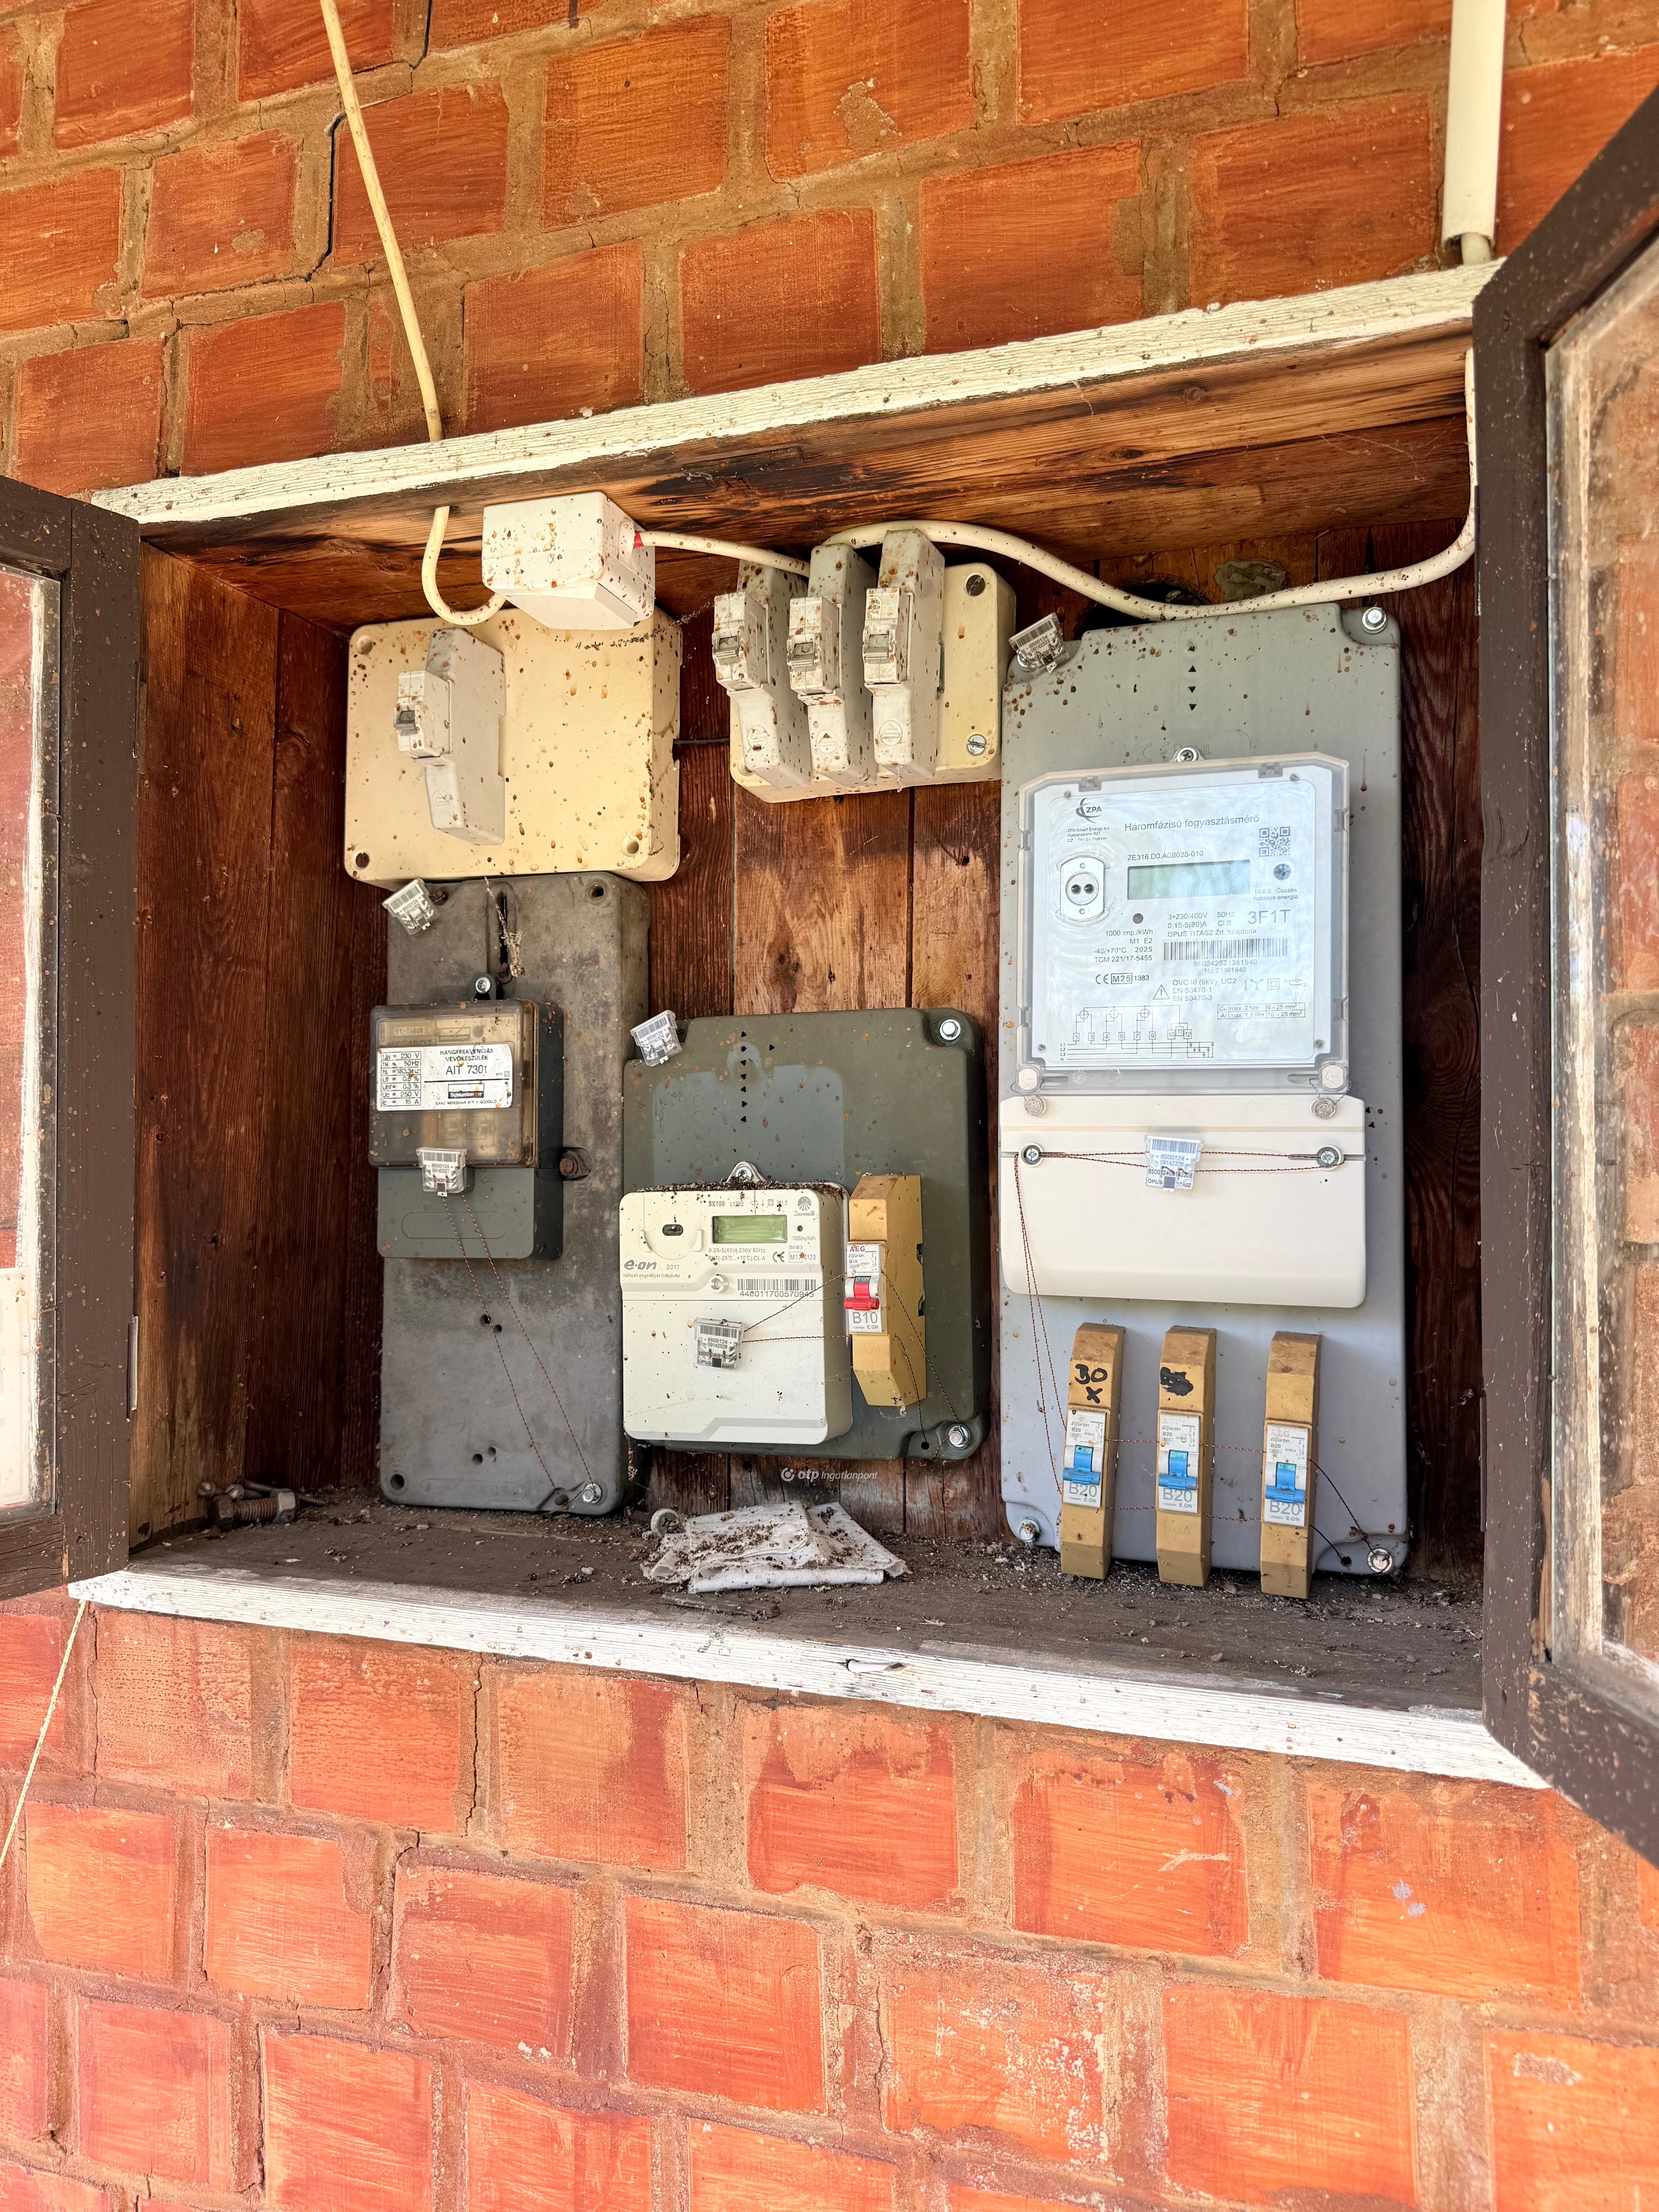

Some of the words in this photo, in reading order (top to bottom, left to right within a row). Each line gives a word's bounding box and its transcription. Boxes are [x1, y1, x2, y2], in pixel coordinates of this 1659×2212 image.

[1029, 635, 1048, 649] 8500124
[1125, 819, 1182, 831] Háromfázisú
[1185, 814, 1259, 828] fogyasztásmérő
[1248, 909, 1291, 924] 3F1T
[1123, 929, 1153, 937] imp./kWh
[1194, 959, 1257, 967] 900242521381840
[647, 1030, 663, 1041] 8500124
[446, 1065, 463, 1075] AIT
[467, 1065, 487, 1074] 7301
[852, 1312, 878, 1324] B10
[1075, 1364, 1108, 1385] 30
[1069, 1482, 1097, 1498] B20
[1163, 1487, 1193, 1503] B20
[1269, 1500, 1300, 1516] B20
